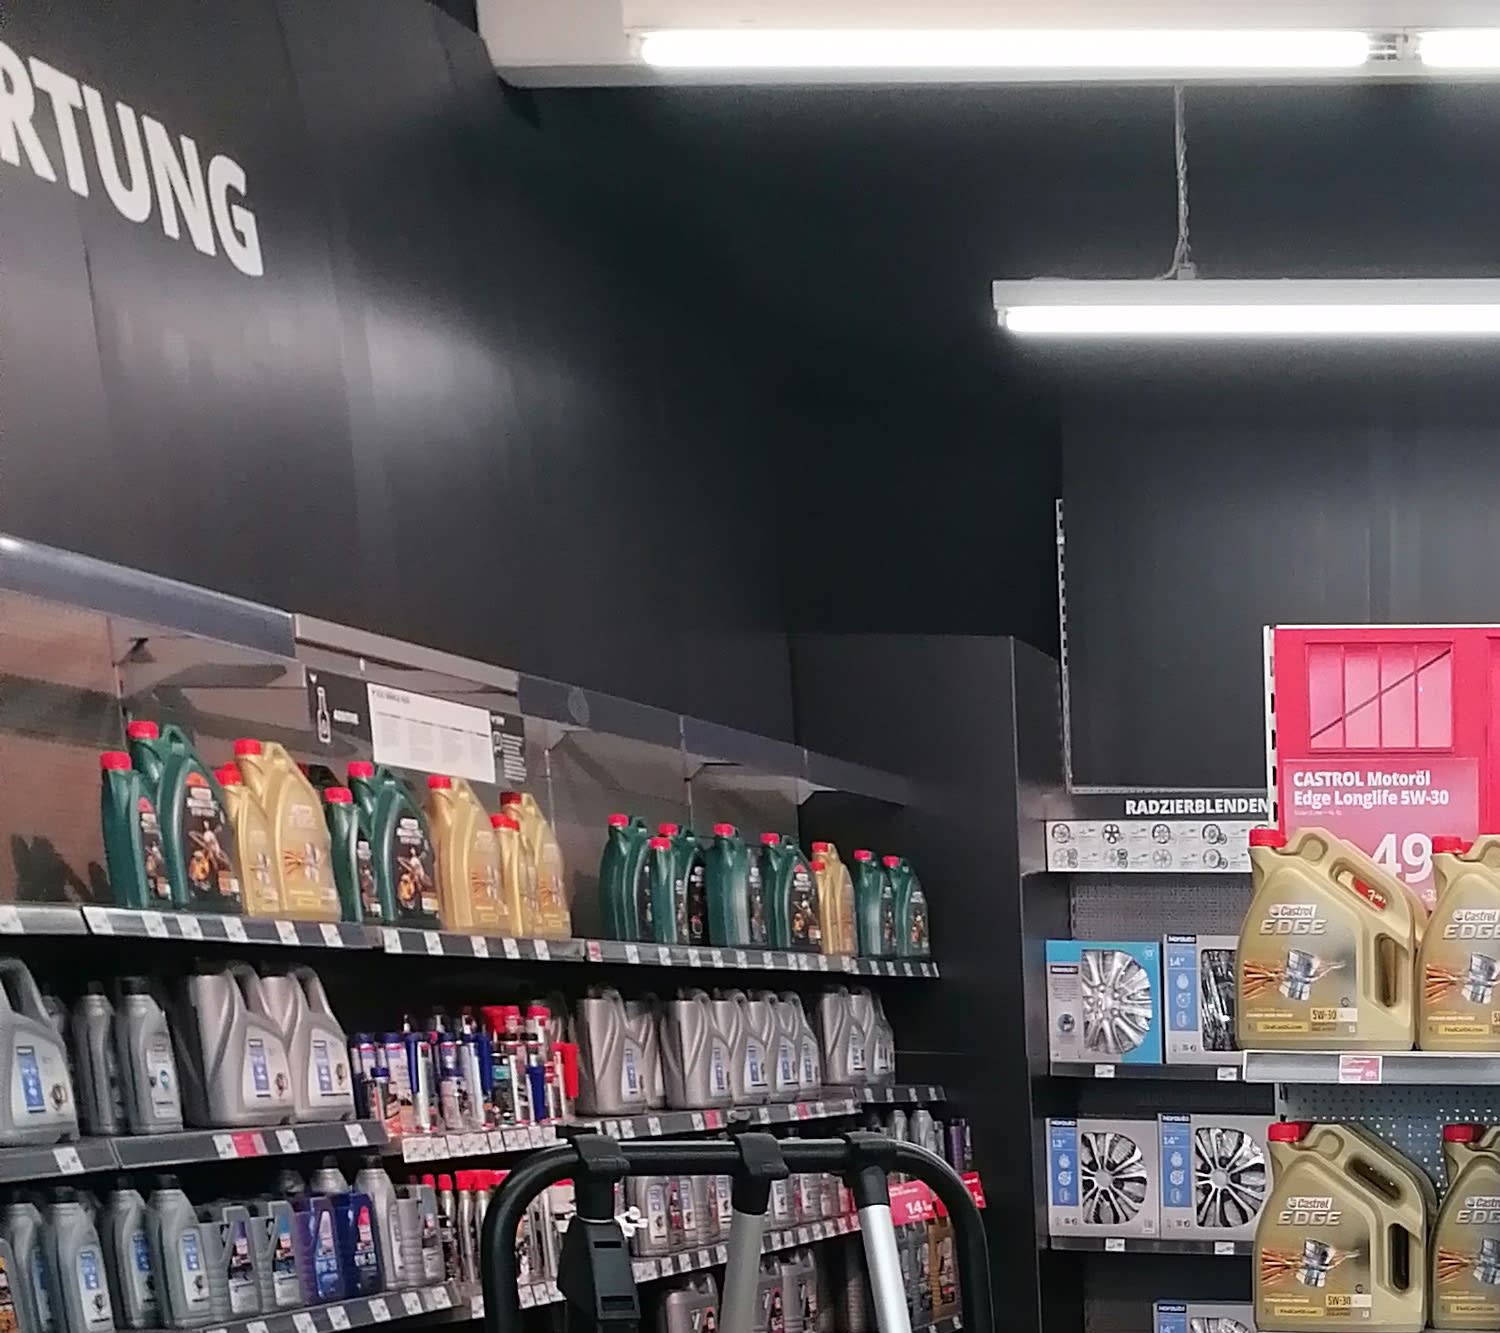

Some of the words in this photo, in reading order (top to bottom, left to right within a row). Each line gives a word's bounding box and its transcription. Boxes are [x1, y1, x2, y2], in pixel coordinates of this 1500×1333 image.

[1293, 772, 1364, 787] CASTROL
[1367, 770, 1431, 787] Motoröl
[1125, 797, 1269, 815] RADZIERBLENDEN
[1294, 791, 1331, 810] Edge
[1334, 790, 1398, 809] Longlife
[1400, 790, 1449, 805] 5W-30
[1372, 832, 1433, 883] 49
[1280, 906, 1315, 918] Castrol
[1464, 911, 1499, 922] Castrol
[1260, 919, 1327, 936] EDGE
[1312, 1010, 1337, 1021] 5W-30
[1298, 1198, 1329, 1209] Castrol
[1277, 1210, 1342, 1226] EDGE
